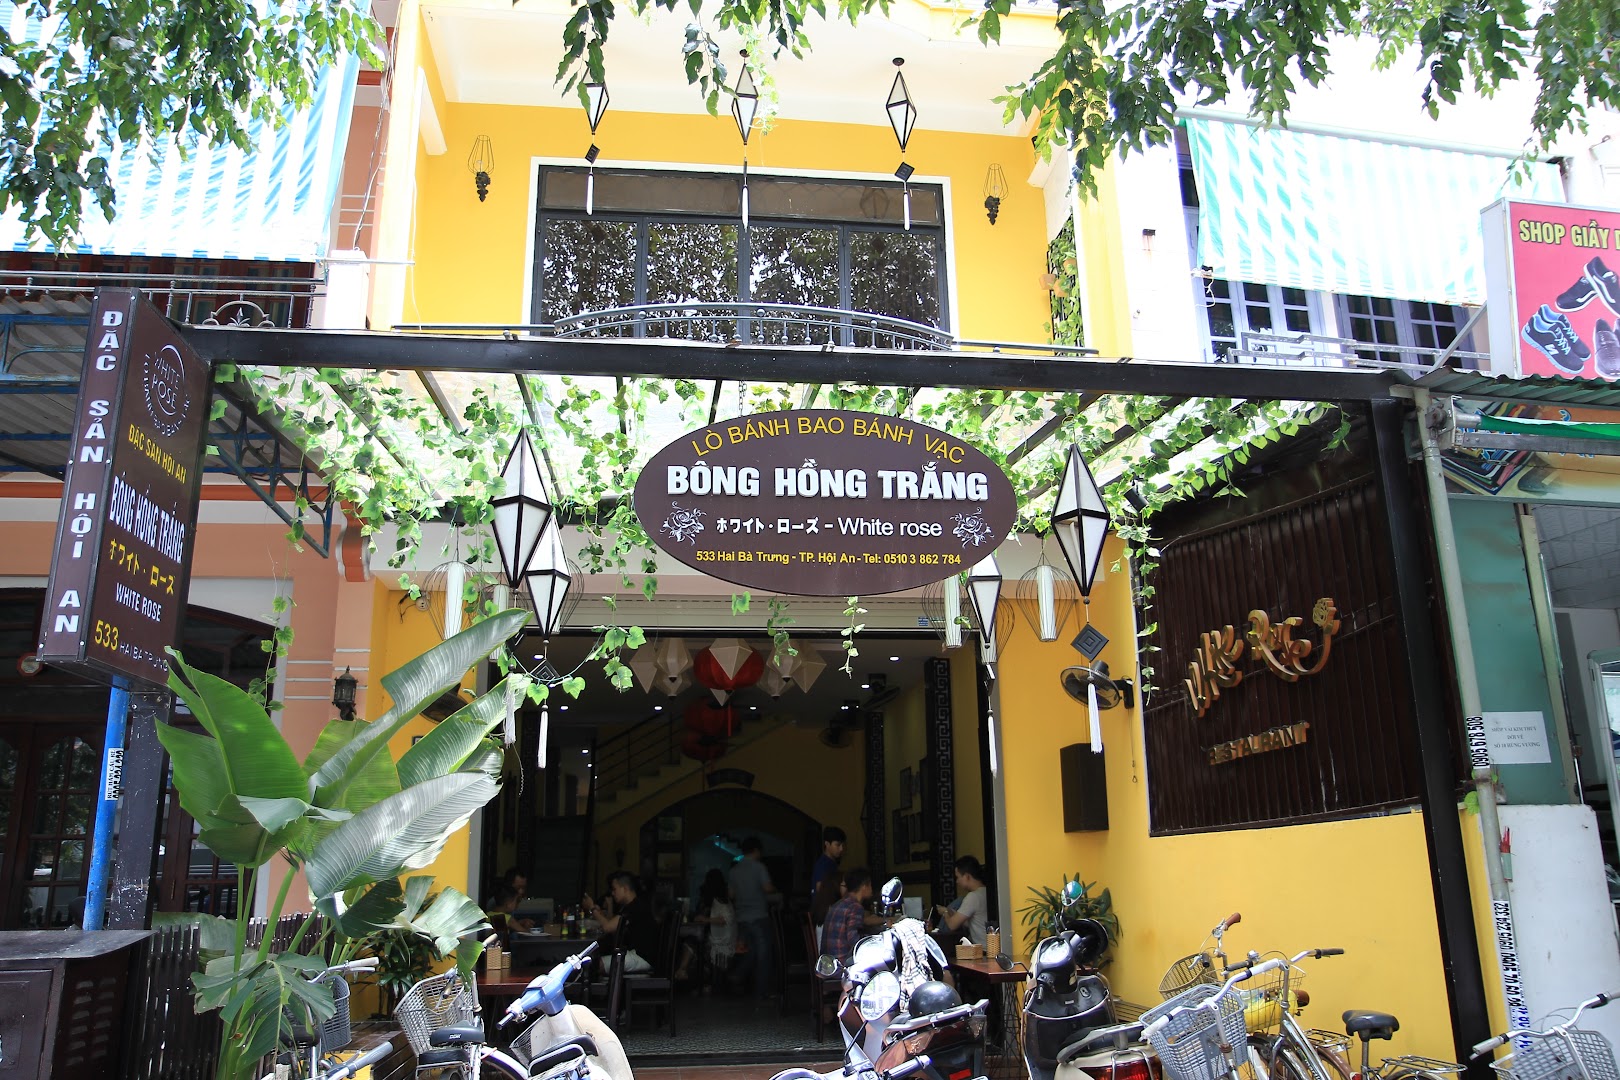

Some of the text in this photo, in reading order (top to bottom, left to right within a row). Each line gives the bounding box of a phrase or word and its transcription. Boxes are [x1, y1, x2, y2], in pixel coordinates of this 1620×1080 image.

[1519, 219, 1566, 245] SHOP
[692, 416, 965, 464] LÒ BÁNH BAO BÁNH VẠC
[54, 310, 124, 633] ĐẶC SẢN HỘI AN
[175, 468, 187, 484] AN
[667, 457, 988, 501] BÔNG HỒNG TRẮNG
[716, 516, 819, 534] ホワイト・ローズ
[838, 517, 894, 536] White
[900, 522, 943, 537] rose
[696, 551, 716, 562] 533
[717, 552, 735, 562] Hai
[738, 552, 753, 562] Bà
[756, 552, 789, 565] Trưng
[799, 552, 815, 563] TP.
[818, 553, 837, 565] Hội
[840, 554, 856, 564] An
[863, 553, 882, 564] Tel:
[884, 554, 908, 564] 0510
[909, 554, 917, 564] 3
[919, 554, 939, 565] 862
[942, 554, 961, 565] 784
[116, 582, 162, 622] WHITE ROSE
[94, 619, 119, 650] 533
[1466, 715, 1490, 767] 0905.678.508
